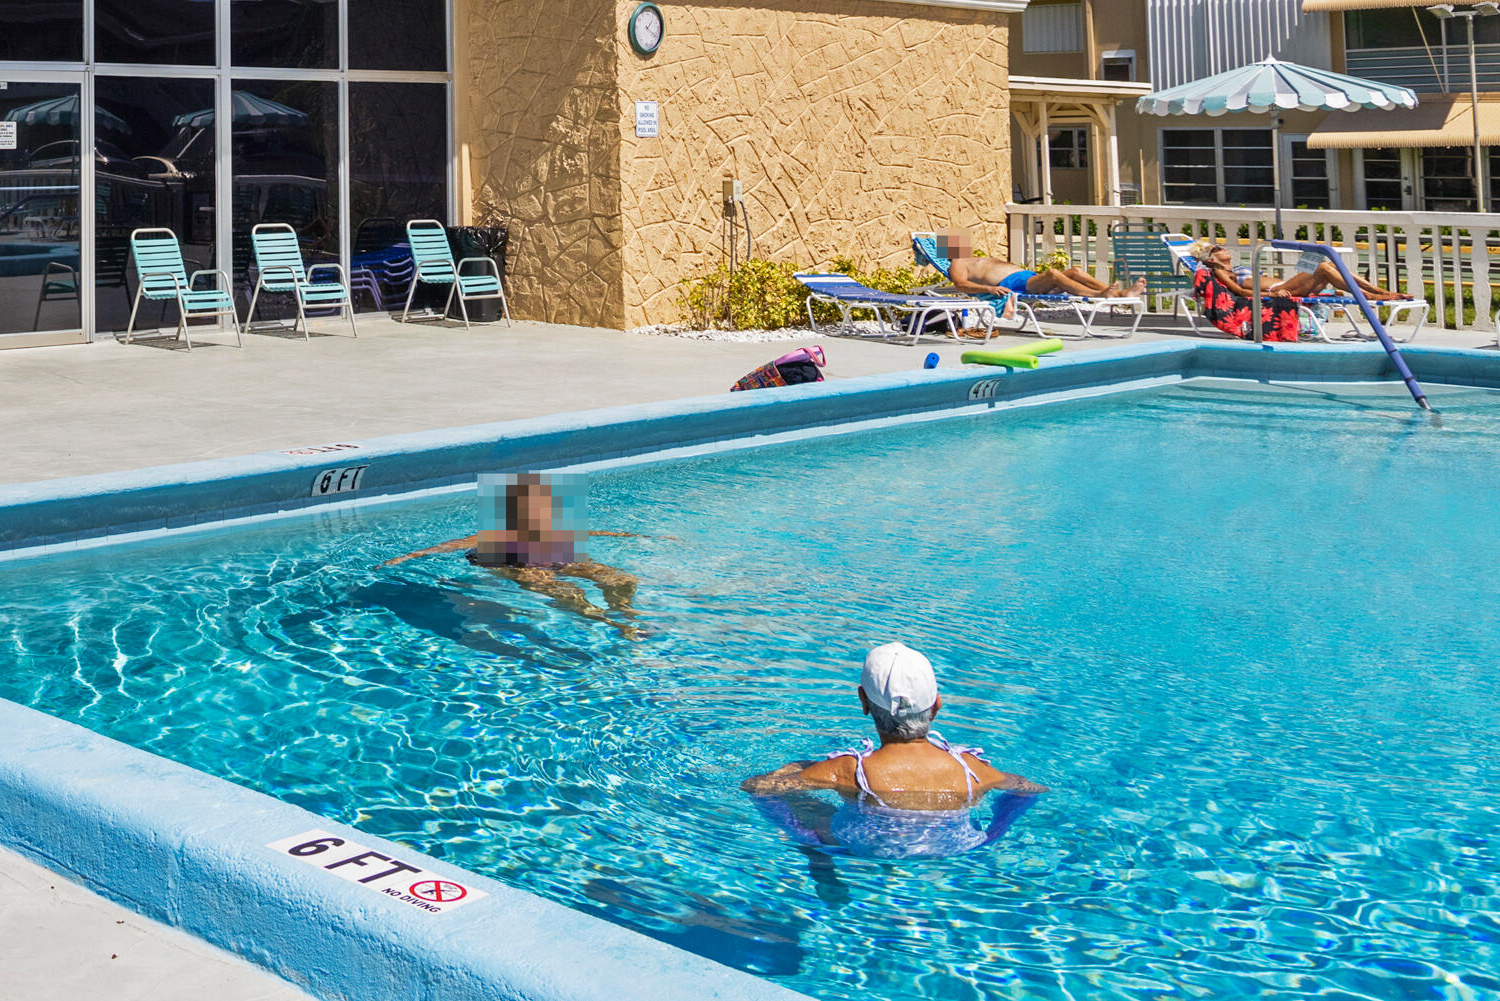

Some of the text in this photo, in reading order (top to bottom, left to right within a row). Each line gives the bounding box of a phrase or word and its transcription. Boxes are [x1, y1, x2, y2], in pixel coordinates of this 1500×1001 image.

[320, 465, 368, 493] 6 FT
[287, 837, 422, 884] 6 FT
[381, 887, 442, 913] NO DIVING
